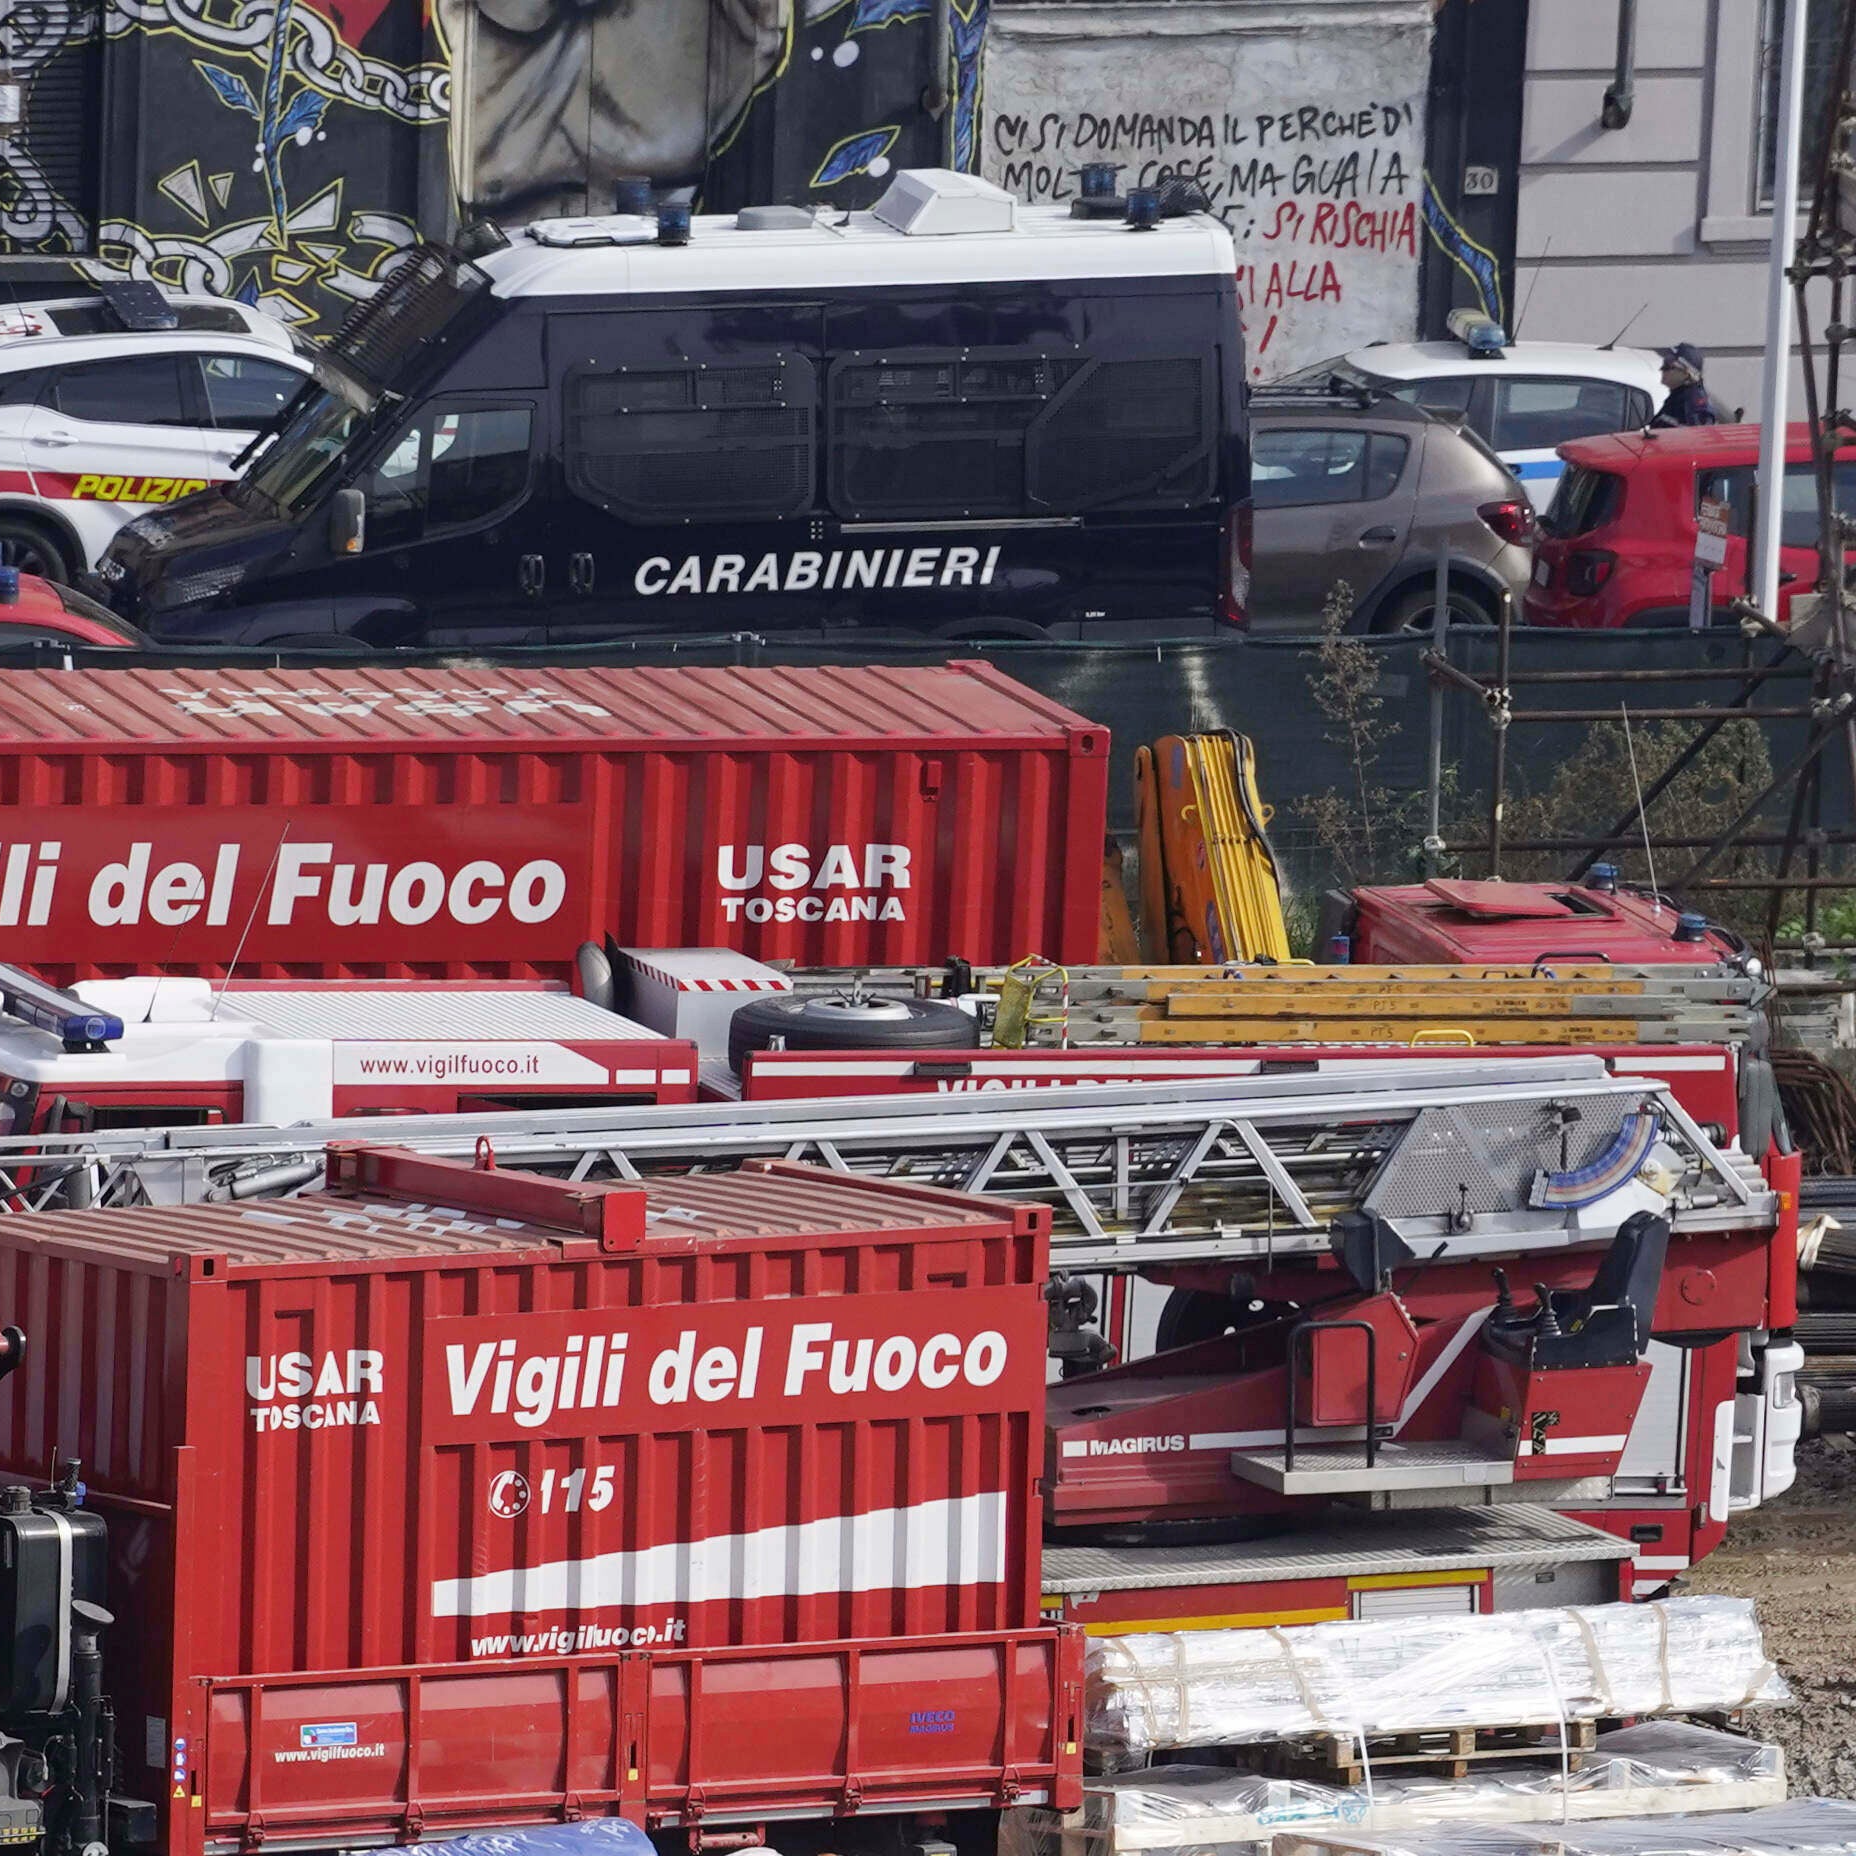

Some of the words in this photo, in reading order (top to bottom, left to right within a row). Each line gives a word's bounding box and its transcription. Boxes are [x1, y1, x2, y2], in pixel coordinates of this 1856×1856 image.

[1031, 114, 1067, 152] SI
[1073, 112, 1215, 154] DOMANDA
[1223, 113, 1248, 144] IL
[1228, 157, 1285, 197] MA
[1466, 172, 1494, 190] 30
[1262, 201, 1302, 240] SI
[1309, 201, 1415, 256] RISCHIA
[1264, 260, 1341, 308] ALLA
[635, 546, 1001, 596] CARABINIERI
[88, 843, 241, 928] del
[267, 843, 568, 928] Fuoco
[718, 844, 913, 891] USAR
[721, 897, 907, 922] TOSCANA
[360, 1055, 539, 1079] www.vigilfuoco.it
[246, 1349, 384, 1401] USAR
[446, 1332, 629, 1427] Vigili
[648, 1326, 764, 1405] del
[783, 1322, 1009, 1397] Fuoco
[250, 1401, 381, 1432] TOSCANA
[1090, 1434, 1185, 1456] MAGIRUS
[540, 1465, 616, 1515] 115
[910, 1711, 955, 1723] IVECO
[275, 1743, 385, 1764] www.vigilfuoco.it
